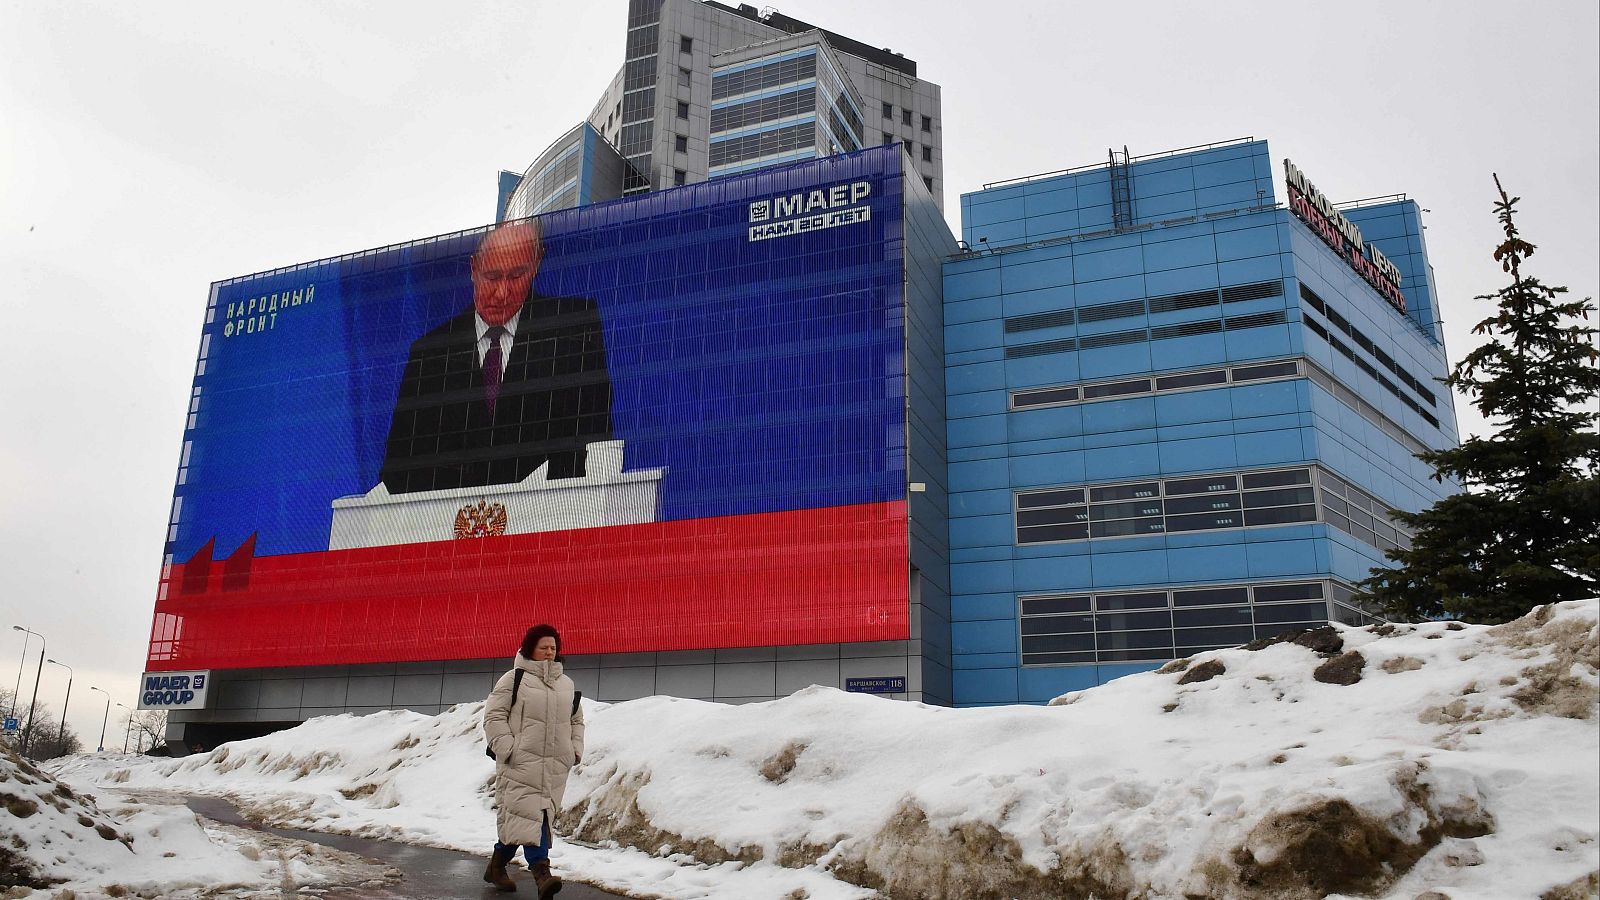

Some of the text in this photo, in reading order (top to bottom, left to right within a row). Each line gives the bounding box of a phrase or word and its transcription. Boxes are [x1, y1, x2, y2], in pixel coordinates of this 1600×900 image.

[774, 181, 871, 218] МАЕР
[752, 209, 867, 239] НАМ 20 ЛЕТ
[1284, 158, 1403, 289] МОСКОВСКИЙ ЦЕНТР
[1287, 186, 1346, 254] БОЕВЫХ
[227, 284, 315, 319] НАРОДНЫЙ
[224, 313, 277, 337] ФРОНТ
[143, 690, 194, 706] GROUP
[145, 676, 190, 690] MAER
[891, 679, 903, 688] 118
